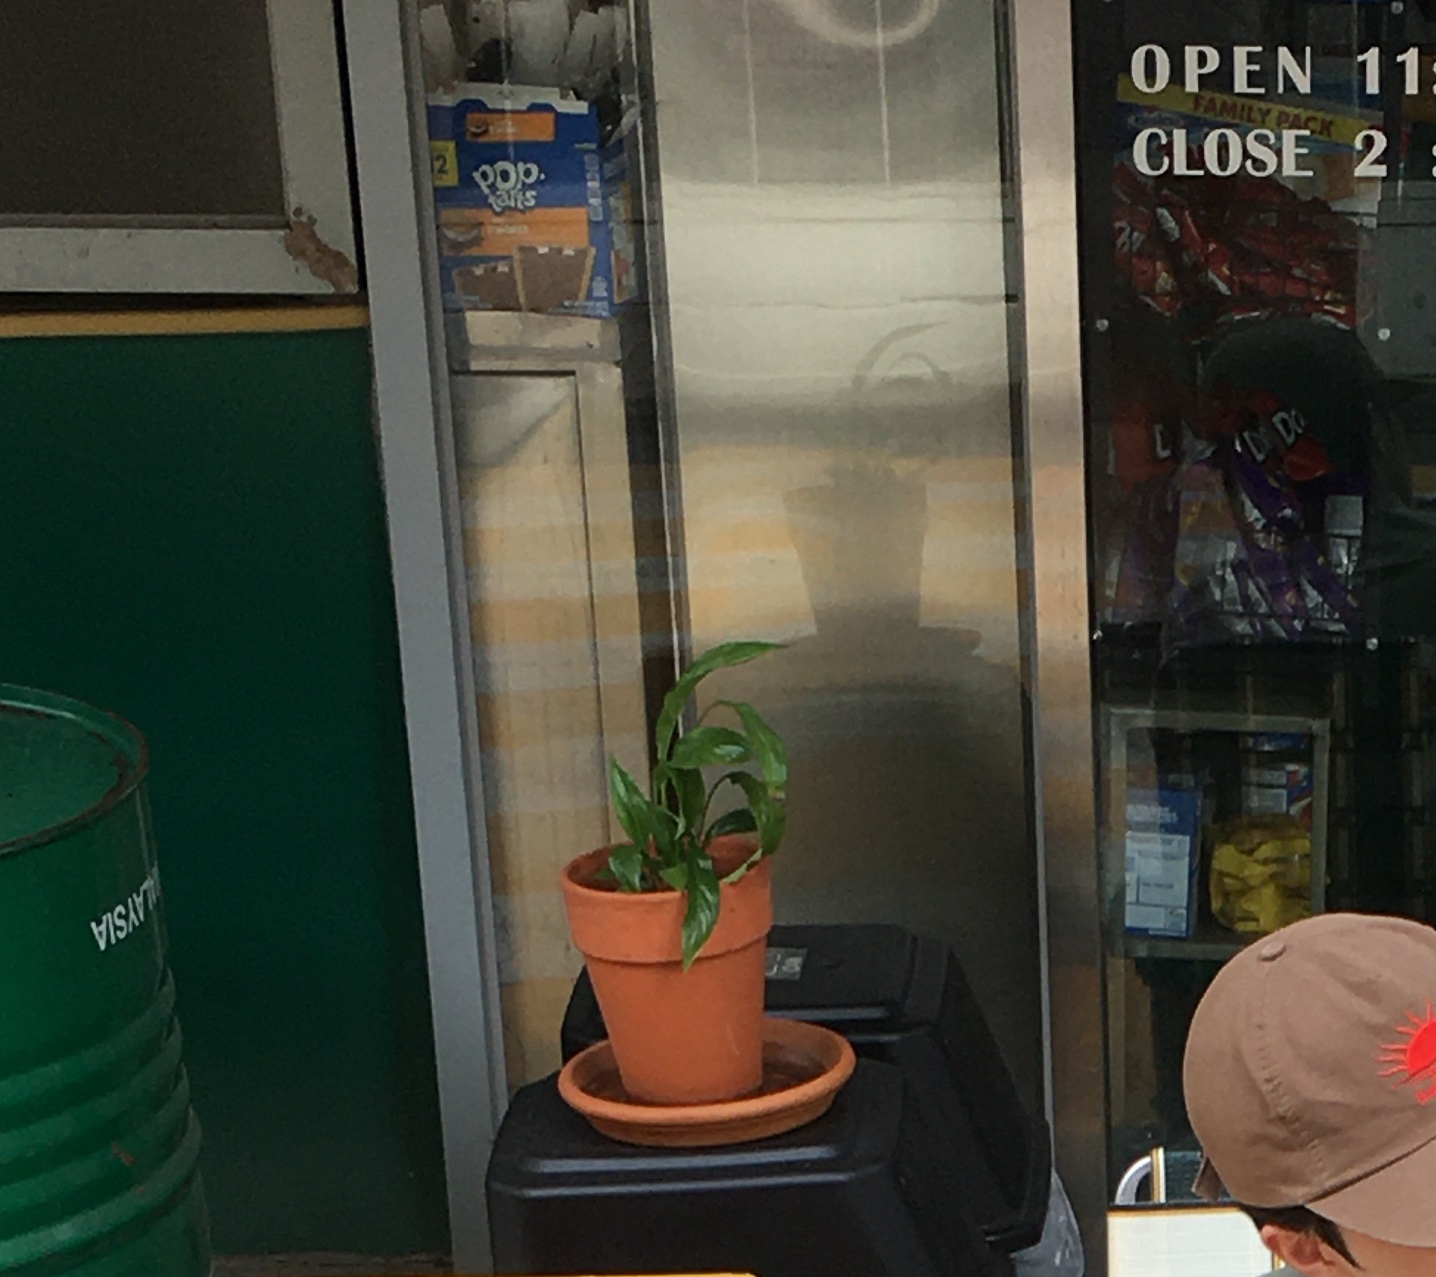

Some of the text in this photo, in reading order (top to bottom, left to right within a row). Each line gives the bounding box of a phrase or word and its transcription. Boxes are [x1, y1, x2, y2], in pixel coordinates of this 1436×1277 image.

[1131, 45, 1311, 94] OPEN
[1193, 94, 1272, 125] FAMILY
[1275, 110, 1334, 138] PACK
[1133, 128, 1314, 177] CLOSE
